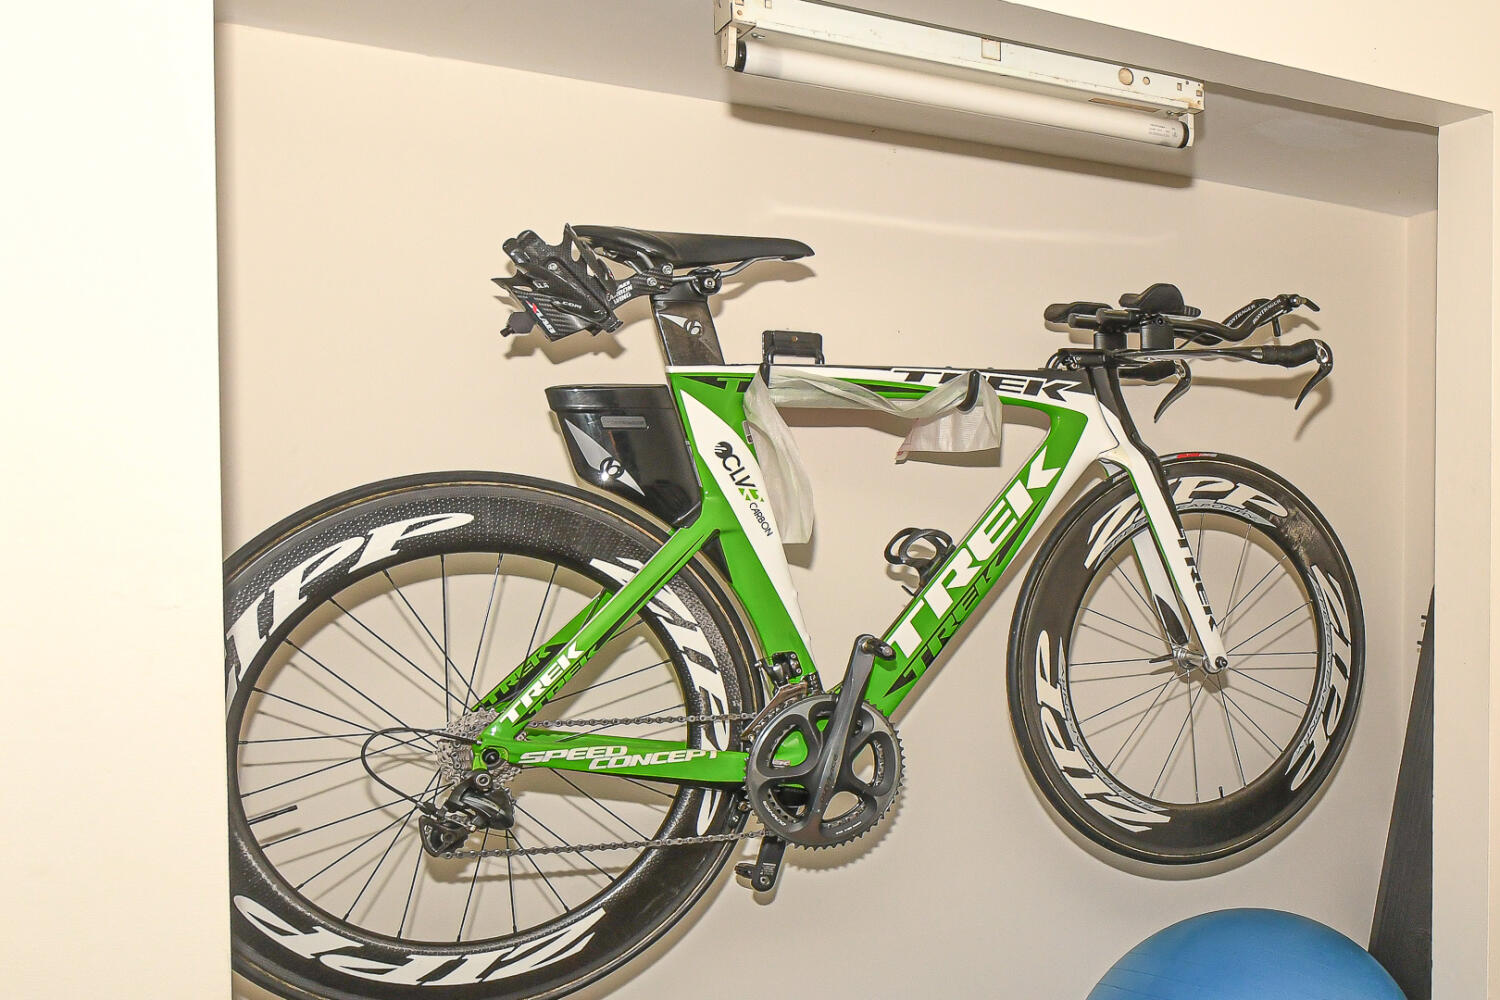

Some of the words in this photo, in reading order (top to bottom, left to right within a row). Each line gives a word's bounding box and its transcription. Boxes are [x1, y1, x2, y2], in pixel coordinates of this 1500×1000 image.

[749, 501, 774, 537] CARBON
[886, 445, 1062, 659] TREK
[500, 641, 584, 723] TREK
[1291, 565, 1351, 791] ZIPP
[518, 745, 628, 764] SPEED
[588, 749, 718, 771] CONCEPT
[1036, 630, 1171, 832] ZIPP
[234, 895, 607, 986] ZIPP
